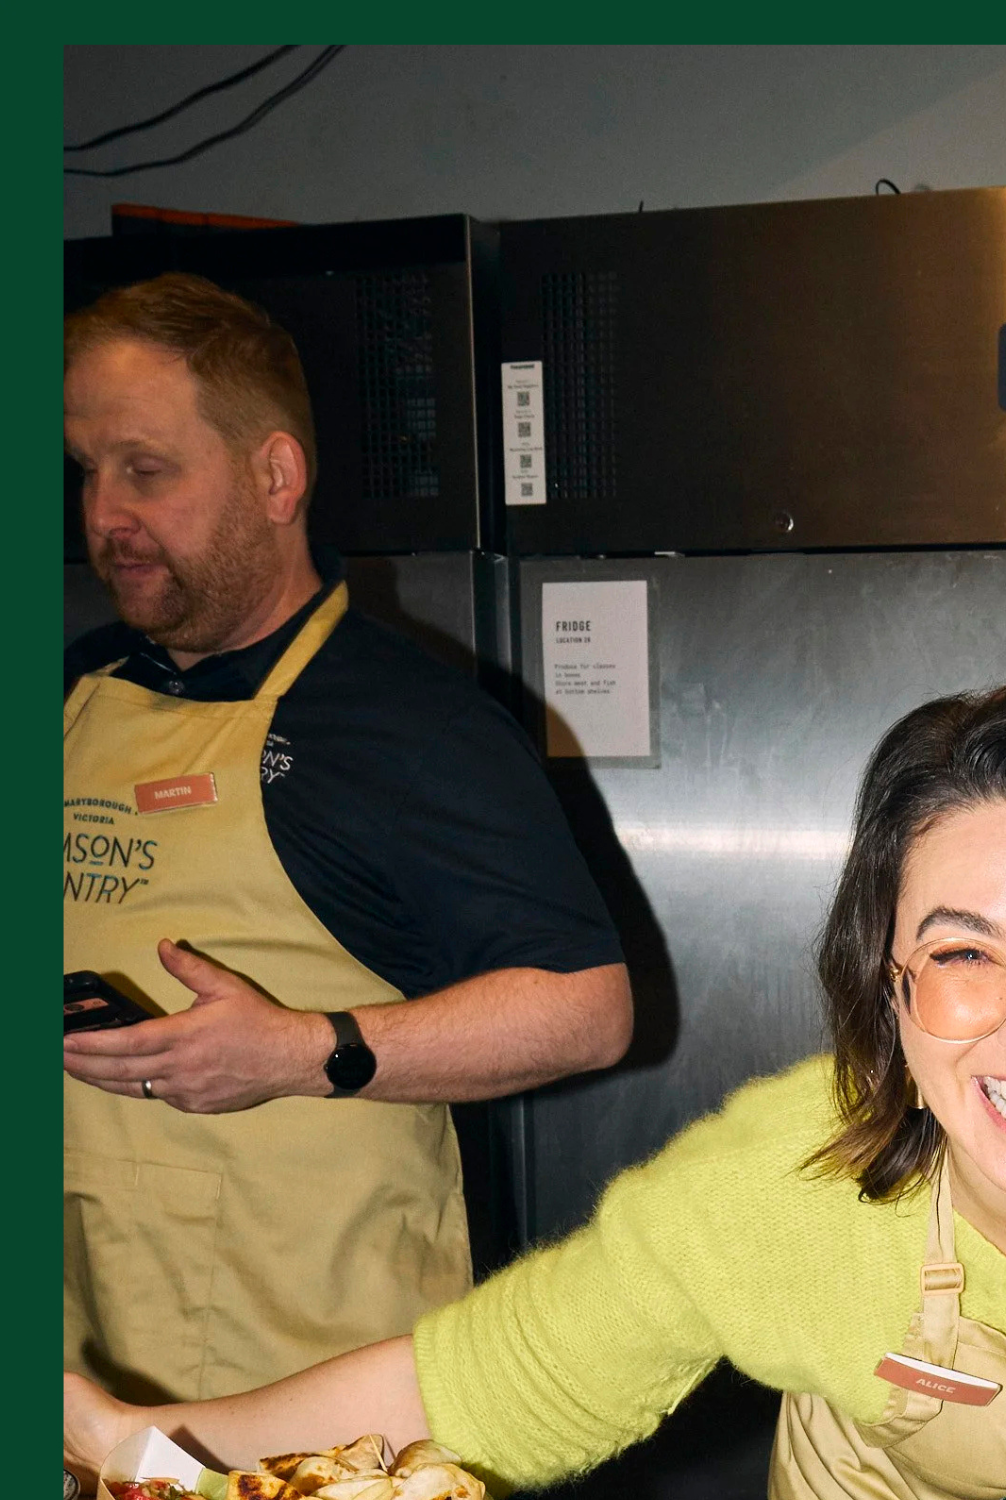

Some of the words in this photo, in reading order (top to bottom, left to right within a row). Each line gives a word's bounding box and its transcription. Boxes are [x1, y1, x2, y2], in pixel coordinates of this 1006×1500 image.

[555, 620, 591, 632] FRIDGE
[556, 636, 583, 644] LOCATION
[154, 786, 192, 800] MARTIN
[73, 812, 115, 825] VICTORIA
[916, 1378, 957, 1394] ALICE
